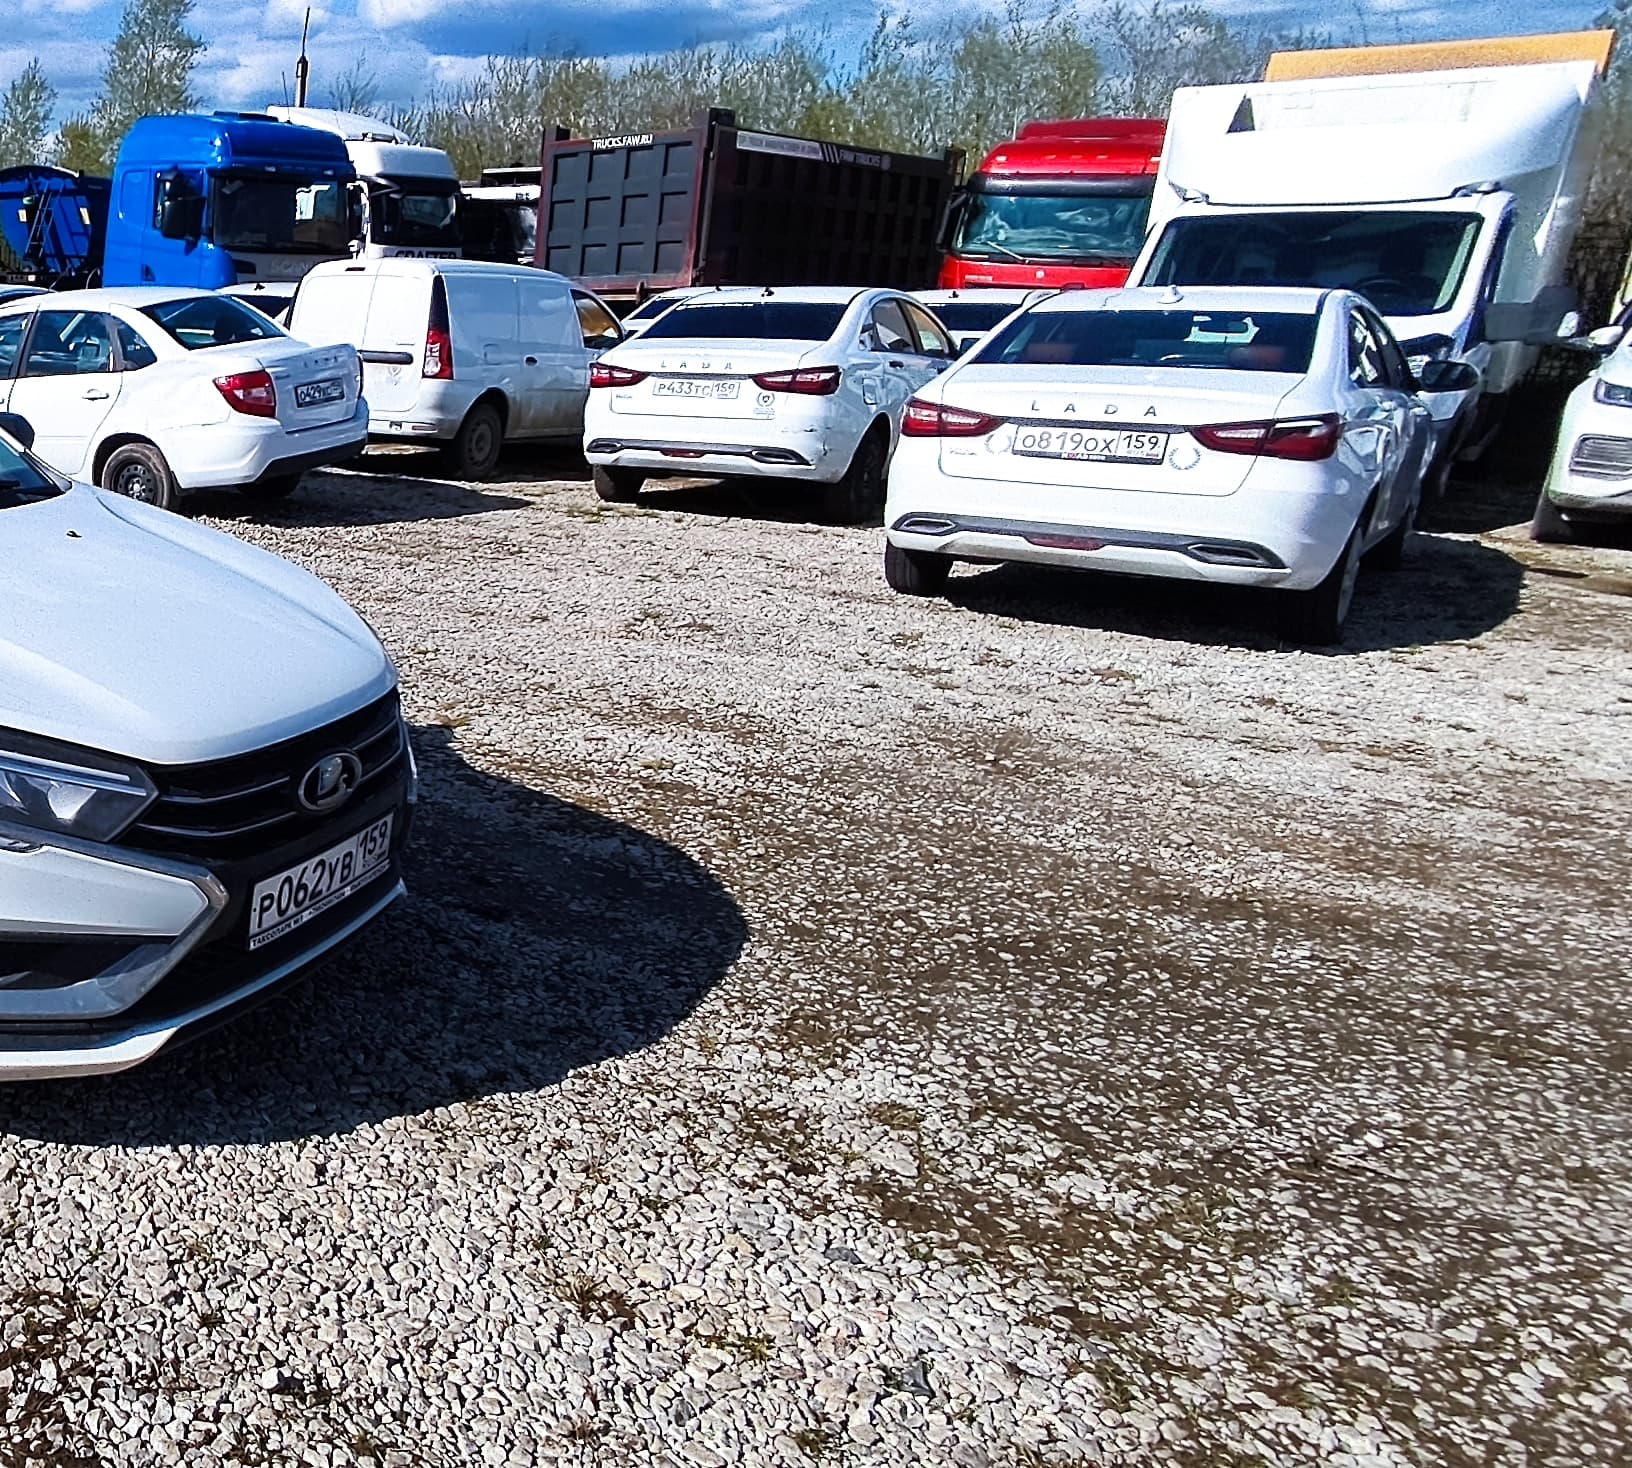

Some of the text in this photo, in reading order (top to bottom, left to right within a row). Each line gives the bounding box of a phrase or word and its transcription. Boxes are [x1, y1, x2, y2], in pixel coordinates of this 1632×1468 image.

[1030, 400, 1158, 417] LADA
[1123, 433, 1161, 451] 159
[257, 850, 354, 929] Р062УВ
[359, 819, 389, 861] 159
